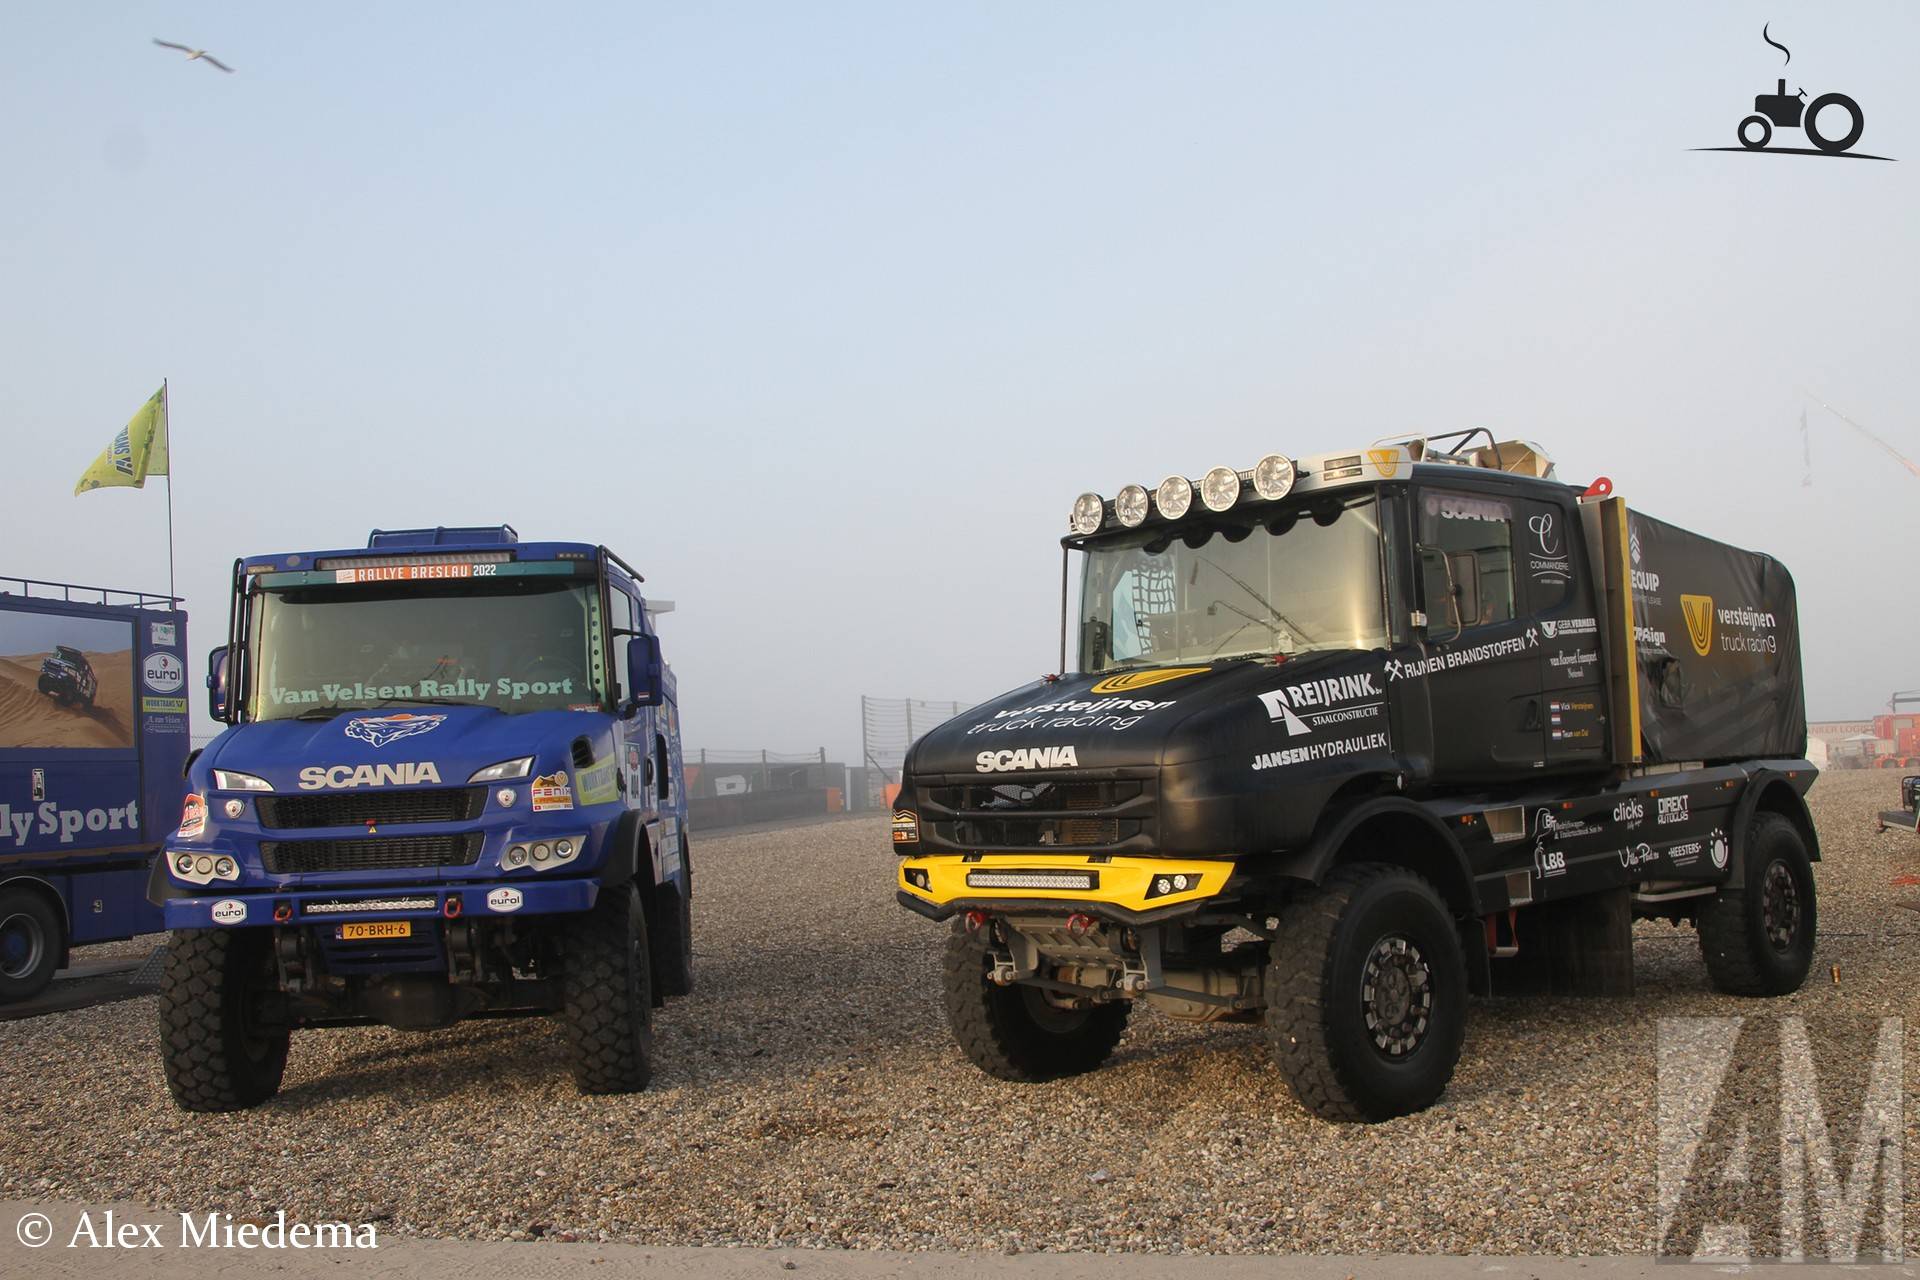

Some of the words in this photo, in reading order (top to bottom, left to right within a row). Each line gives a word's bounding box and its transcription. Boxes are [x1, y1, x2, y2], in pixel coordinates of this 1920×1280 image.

[358, 569, 404, 581] RALLYE
[410, 564, 469, 579] BRESLAU
[473, 564, 497, 576] 2022
[1717, 606, 1776, 631] versteijnen
[1721, 633, 1746, 651] truck
[1747, 635, 1776, 654] racing
[1405, 657, 1447, 678] RIJNEN
[1448, 637, 1526, 668] BRANDSTOFFEN
[147, 668, 181, 681] eurol
[271, 687, 319, 705] Van
[322, 682, 413, 700] Velsen
[419, 679, 491, 700] Rally
[497, 677, 573, 700] Sport
[994, 697, 1177, 719] versteijnen
[1312, 706, 1379, 726] STAALCONSTRUCTIE
[967, 715, 1043, 735] truck
[1042, 712, 1145, 731] racing
[976, 745, 1079, 773] SCANIA
[299, 762, 441, 790] SCANIA
[533, 786, 572, 797] FENIX
[1613, 801, 1644, 822] clicks
[1658, 795, 1689, 815] DIREKT
[38, 800, 138, 843] Sport
[1658, 810, 1689, 825] AUTOGLAS
[1543, 851, 1566, 871] LBB
[490, 896, 519, 905] eurol
[215, 908, 244, 918] eurol
[349, 924, 406, 937] 70-BRH-6
